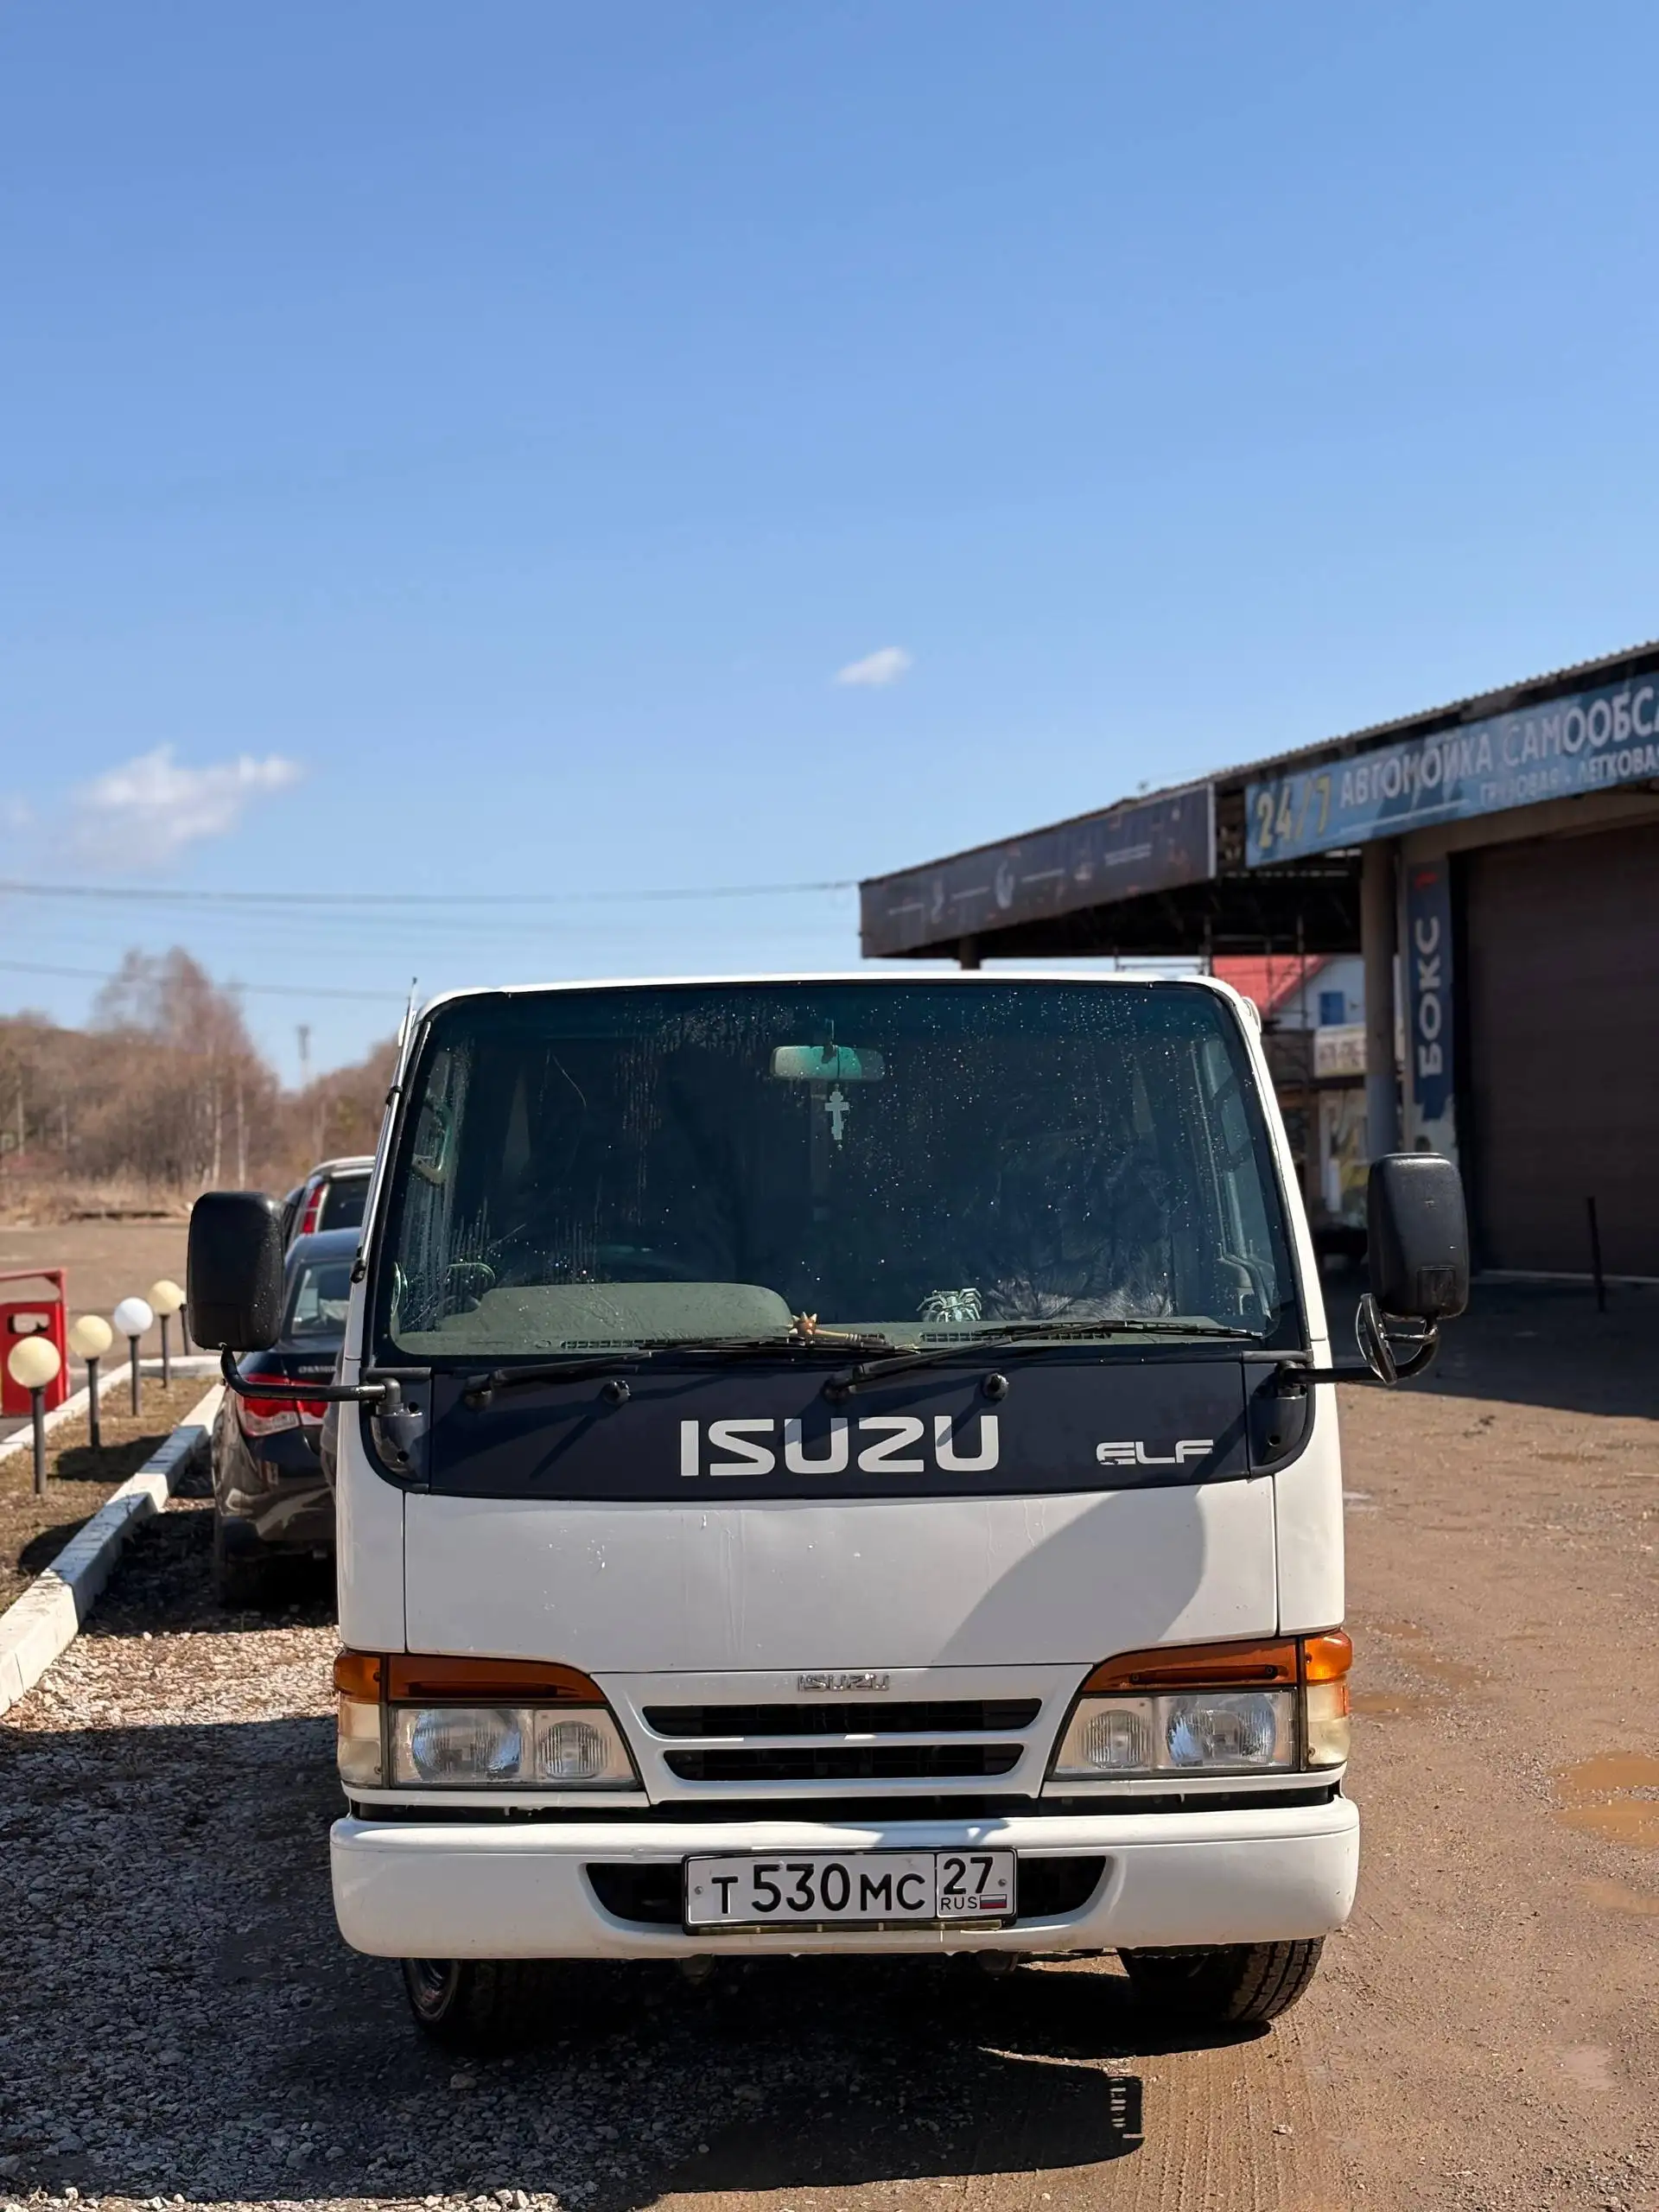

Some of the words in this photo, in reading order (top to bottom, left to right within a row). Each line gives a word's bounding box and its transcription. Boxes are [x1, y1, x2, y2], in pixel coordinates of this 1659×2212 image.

[1256, 773, 1332, 849] 24/7
[1340, 733, 1493, 809] АВТОМОЙКА
[1415, 916, 1443, 1077] БОКС
[680, 1415, 1000, 1477] ISUZU
[1096, 1439, 1214, 1465] ELF
[798, 1673, 891, 1692] ISUZU
[943, 1856, 994, 1895] 27
[940, 1896, 978, 1910] RUS
